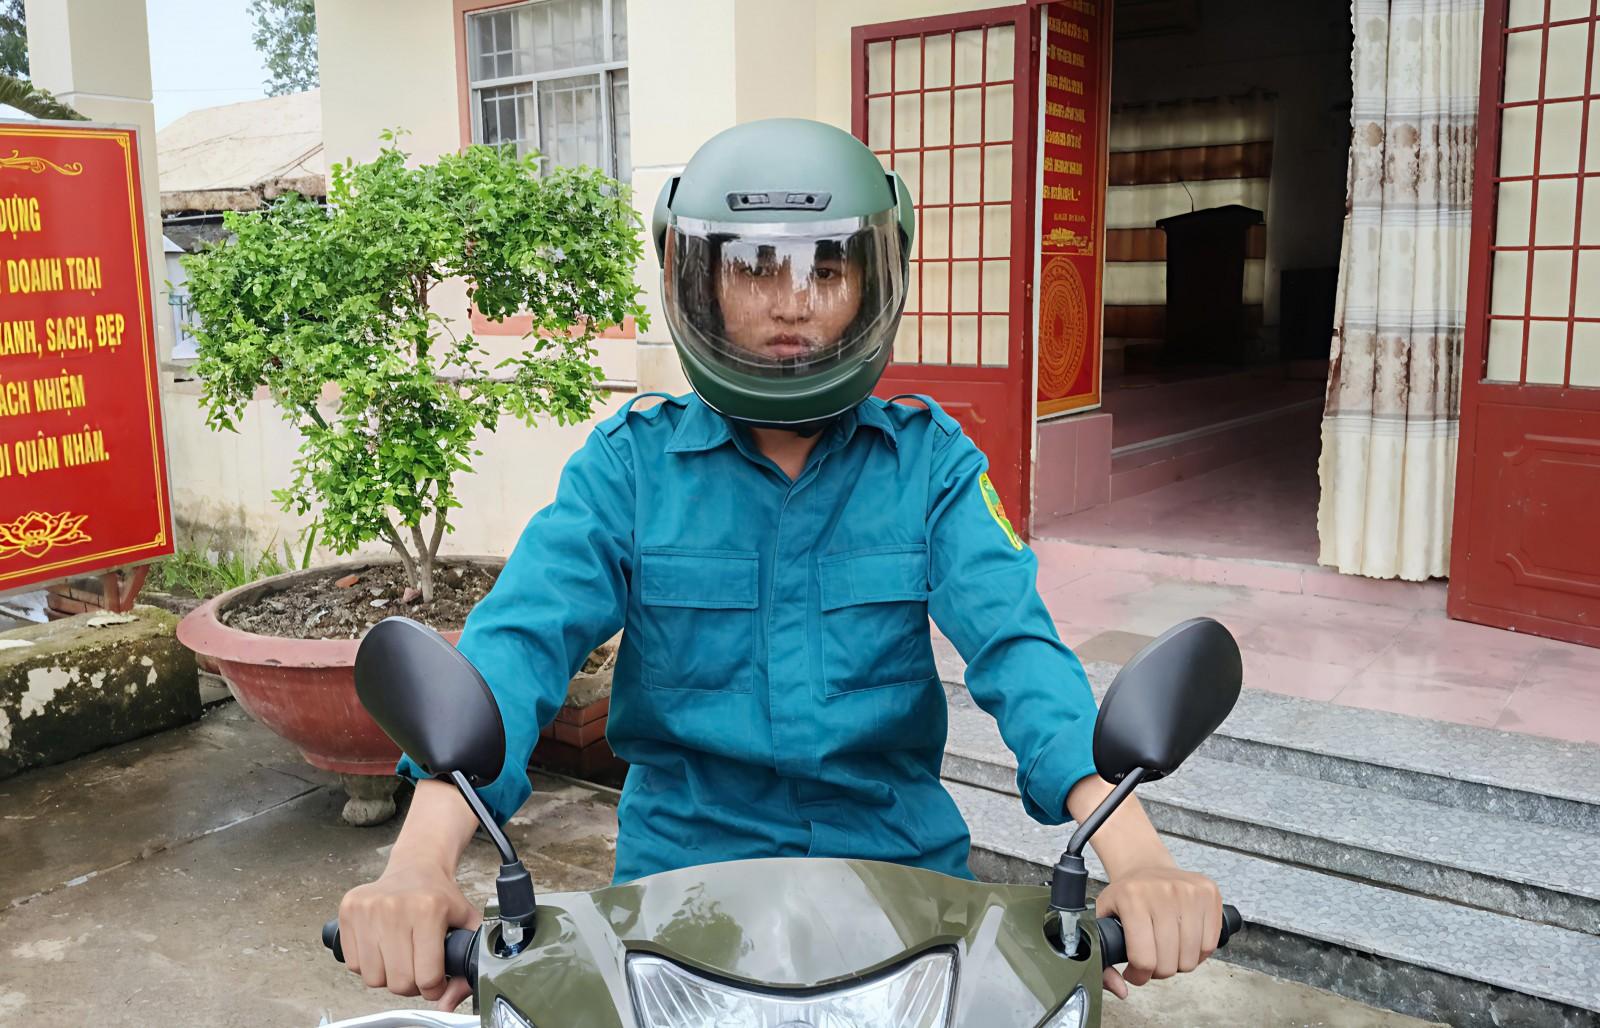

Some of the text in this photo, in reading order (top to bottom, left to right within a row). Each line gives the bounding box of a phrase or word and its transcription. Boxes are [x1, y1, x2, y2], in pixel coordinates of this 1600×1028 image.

[7, 257, 101, 297] DOANH TRẠI
[0, 313, 125, 359] ANH, SẠCH, ĐẸP
[33, 368, 86, 416] NHIỆM
[15, 430, 59, 478] QUÂN
[62, 424, 109, 467] NHÂN.
